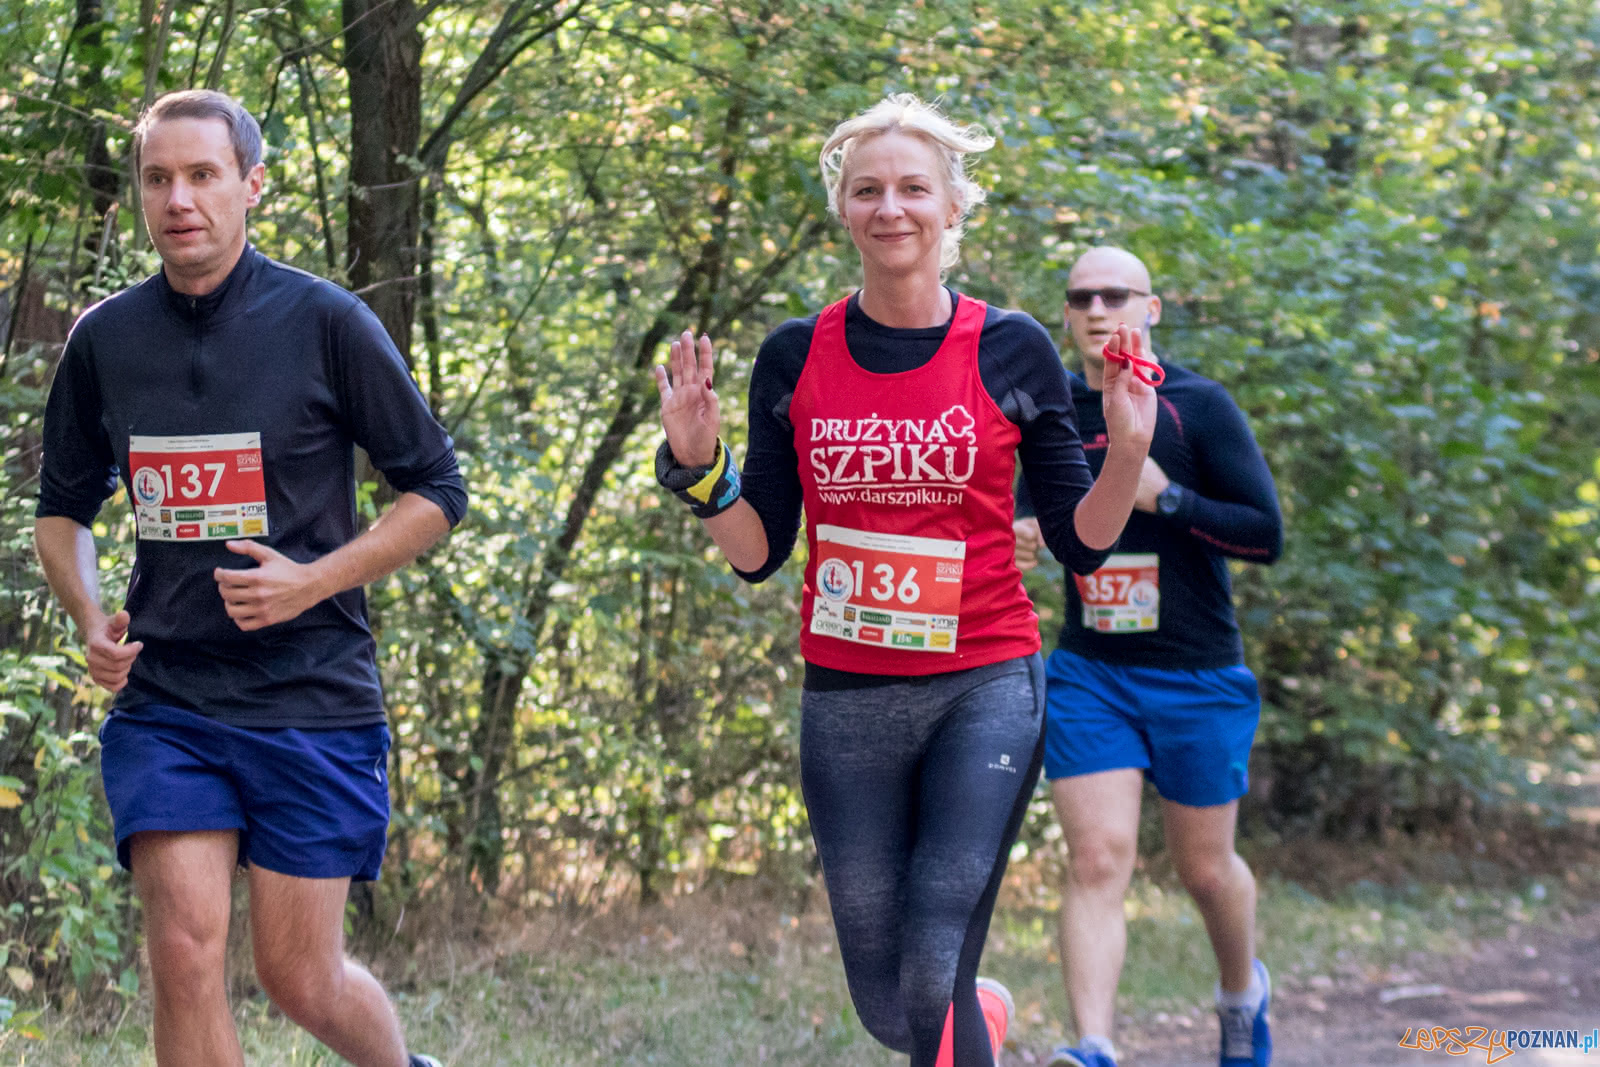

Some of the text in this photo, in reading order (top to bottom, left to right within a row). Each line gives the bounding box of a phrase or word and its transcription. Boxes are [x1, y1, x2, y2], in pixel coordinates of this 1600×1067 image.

[809, 413, 948, 442] DRUŻYNA
[810, 443, 979, 485] SZPIKU
[160, 463, 226, 499] 137
[818, 488, 963, 506] www.darszpiku.pl
[852, 560, 920, 604] 136
[1086, 574, 1132, 602] 357
